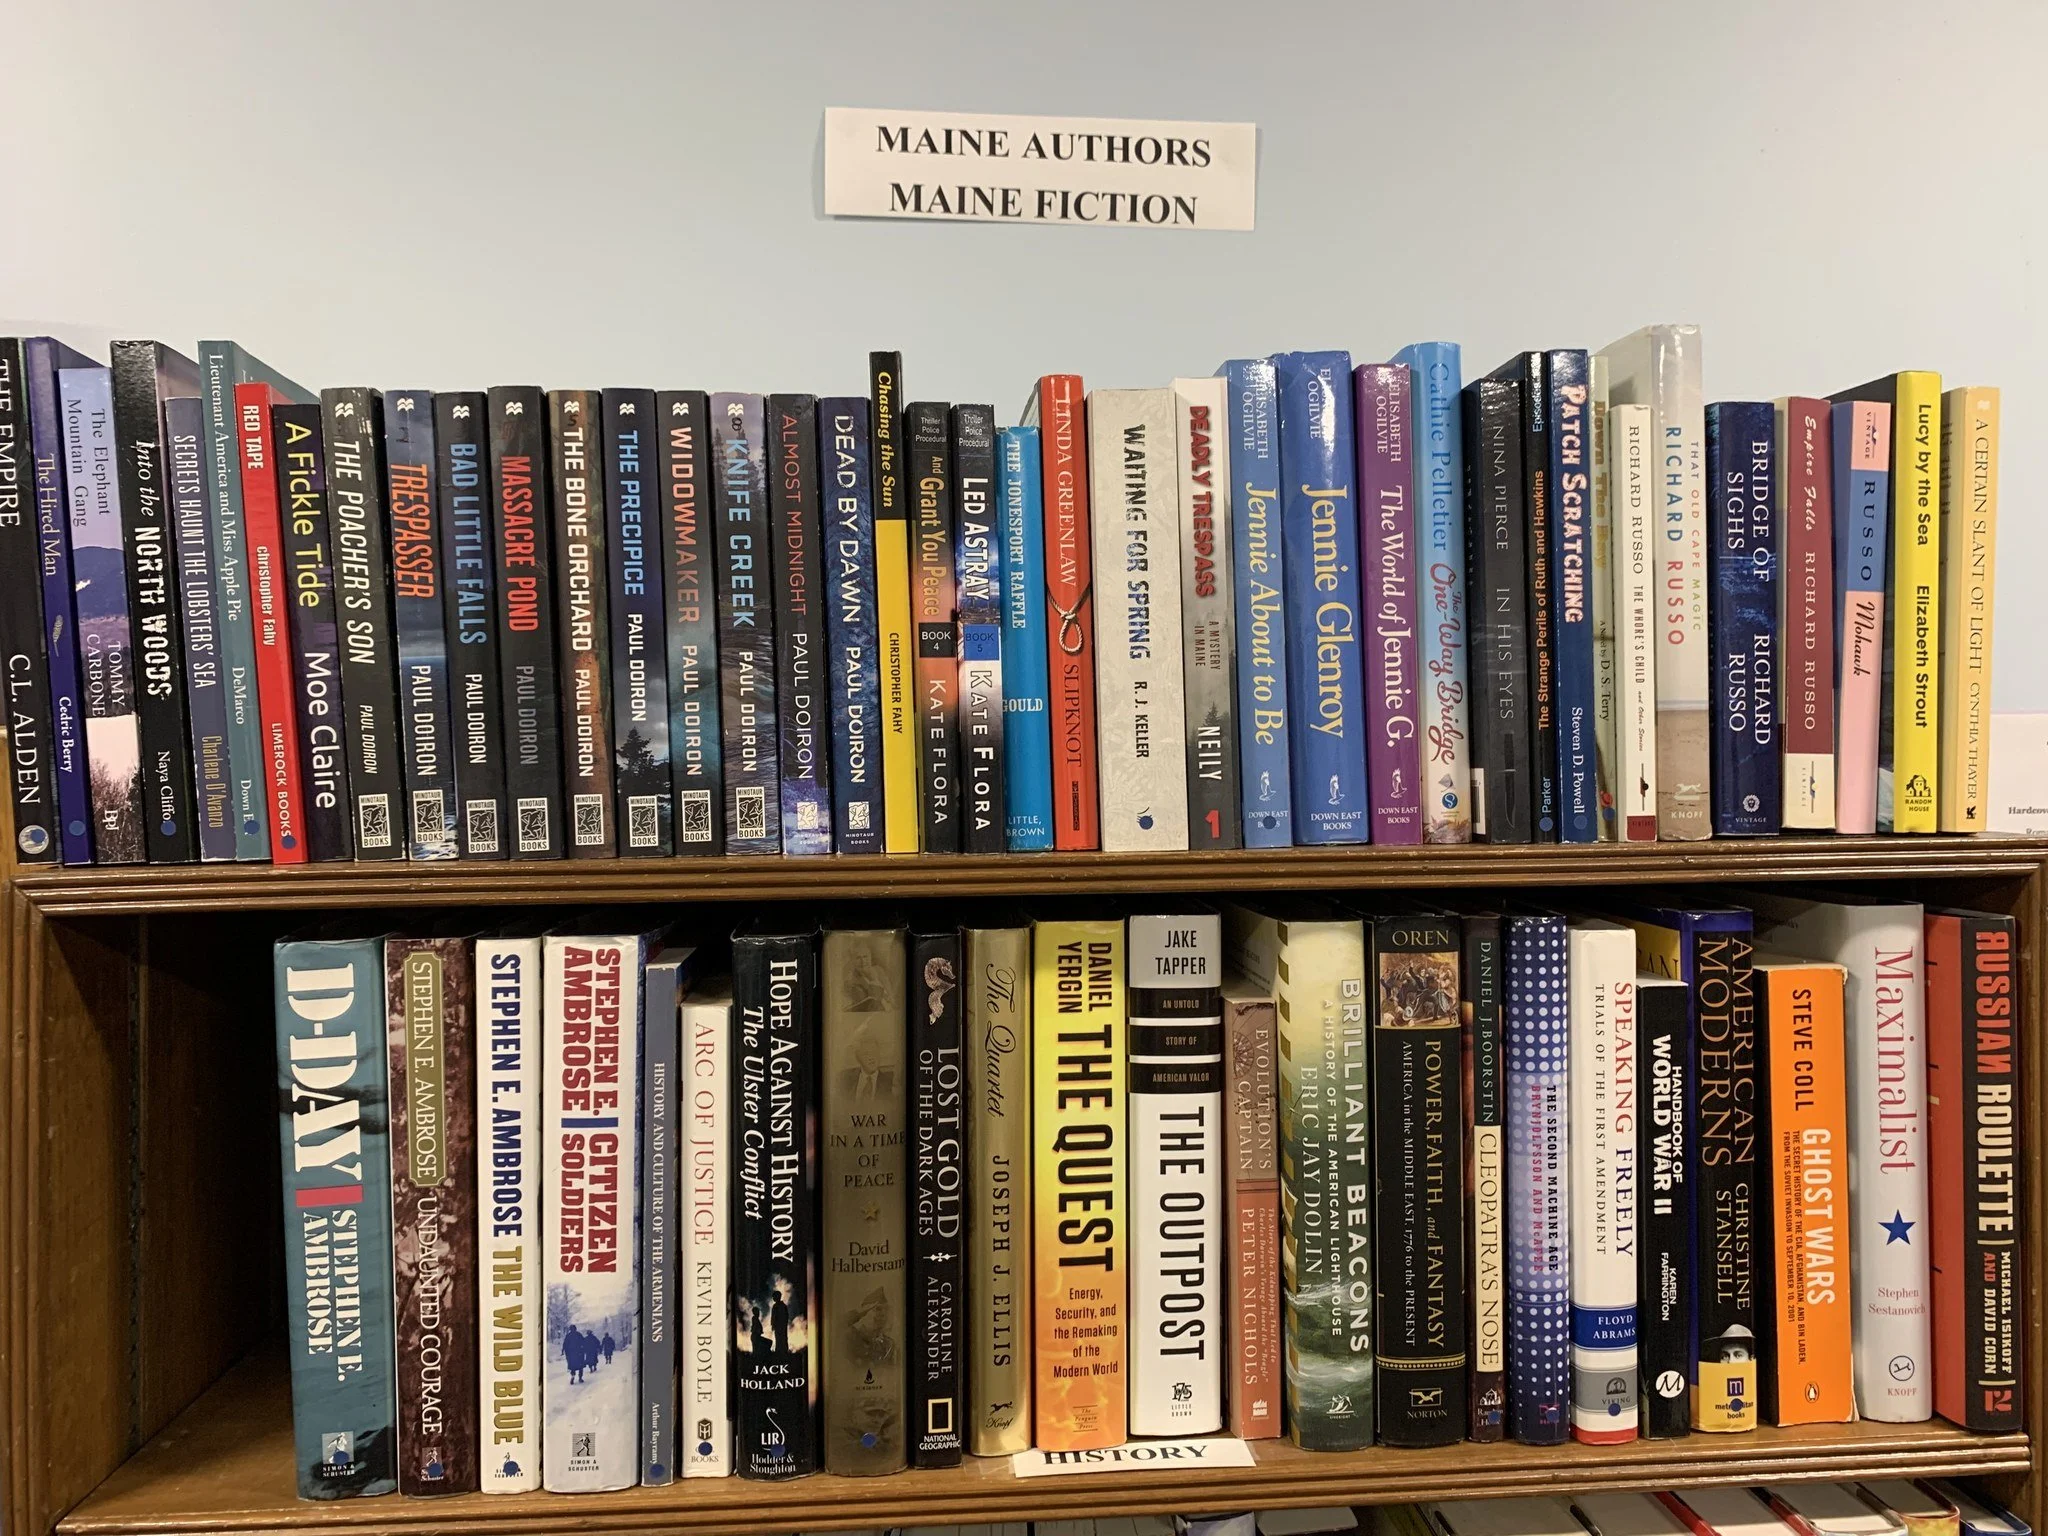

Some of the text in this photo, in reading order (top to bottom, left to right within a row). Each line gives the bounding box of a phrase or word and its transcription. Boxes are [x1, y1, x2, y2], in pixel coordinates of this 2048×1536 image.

[876, 125, 1211, 168] MAINE AUTHORS
[889, 183, 1197, 224] MAINE FICTION
[243, 405, 263, 469] RED TAPE
[878, 372, 895, 507] Chasing the Sun
[915, 434, 946, 443] Procedural
[921, 417, 940, 425] Thriller
[922, 426, 940, 434] Police
[67, 400, 87, 527] Mountain Gang
[90, 409, 109, 515] The Elephant
[209, 354, 240, 621] Lieutenant America and Miss Apple Pie
[1915, 404, 1931, 545] Lucy by the Sea
[37, 454, 61, 576] The Hired Man
[285, 422, 325, 606] A Fickle Tide
[391, 464, 434, 598] TRESPASSER
[671, 427, 699, 622] WIDOWMAKER
[1006, 440, 1025, 629] THE JONESPORT RAFFLE
[1727, 472, 1745, 550] SIGHS
[1752, 440, 1770, 582] BRIDGE OF
[451, 444, 487, 643] BAD LITTLE FALLS
[922, 631, 950, 640] BOOK
[1301, 485, 1353, 738] Jennie Glenroy
[87, 634, 105, 716] CARBONE
[108, 641, 124, 706] TOMMY
[933, 642, 939, 650] 4
[1194, 625, 1205, 666] IN MAINE
[1209, 630, 1221, 670] MYSTERY
[1916, 586, 1930, 728] Elizabeth Strout
[889, 632, 902, 734] CHRISTOPHER FAHY
[9, 654, 41, 804] C.L. ALDEN
[59, 697, 73, 773] Cedric Berry
[304, 652, 339, 809] Moe Claire
[411, 665, 437, 776] PAUL DOIRON
[970, 670, 993, 830] KATE FLORA
[271, 723, 292, 836] LIMEROCK BOOKS
[1197, 726, 1222, 780] NEILY
[417, 833, 443, 841] BOOKS
[1006, 827, 1044, 836] BROWN
[1009, 816, 1041, 825] LITTLE,
[1311, 812, 1361, 821] DOWN EAST
[1323, 821, 1352, 830] BOOKS
[1156, 957, 1206, 975] TAPPER
[1165, 930, 1197, 948] JAKE
[1392, 930, 1449, 946] OREN
[1163, 1000, 1199, 1008] AN UNTOLD
[286, 963, 363, 1181] D-DAY
[1165, 1037, 1197, 1045] STORY OF
[1793, 989, 1814, 1111] STEVE COLL
[1875, 947, 1917, 1174] Maximalist
[1153, 1073, 1209, 1082] AMERICAN VALOR
[919, 1049, 933, 1236] OF THE DARK AGES
[1595, 984, 1606, 1254] TRIALS OF THE FIRST AMENDMENT
[652, 1063, 665, 1342] HISTORY AND CULTURE OF THE ARMENIANS
[1787, 1235, 1793, 1243] TO
[303, 1213, 333, 1354] AMBROSE
[332, 1210, 362, 1382] STEPHEN E.
[417, 1197, 442, 1434] UNDAUNTED COURAGE
[1056, 1304, 1116, 1320] Security, and
[1070, 1288, 1103, 1300] Energy,
[1243, 1208, 1257, 1385] PETER NICHOLS
[1868, 1304, 1925, 1316] Sestanovich
[1878, 1288, 1919, 1300] Stephen
[1984, 1253, 1996, 1374] AND DAVID CORN
[2001, 1252, 2012, 1374] MICHAEL ISIKOFF
[696, 1262, 712, 1403] KEVIN BOYLE
[1054, 1324, 1117, 1338] the Remaking
[1073, 1345, 1100, 1357] of the
[1593, 1328, 1635, 1339] ABRAMS
[1598, 1315, 1633, 1325] FLOYD
[741, 1378, 804, 1389] HOLLAND
[753, 1365, 789, 1374] JACK
[1054, 1362, 1118, 1377] Modern World
[1887, 1388, 1917, 1396] KNOPF
[920, 1441, 960, 1449] GEOGRAPHIC
[924, 1434, 956, 1442] NATIONAL
[1044, 1445, 1207, 1465] HISTORY
